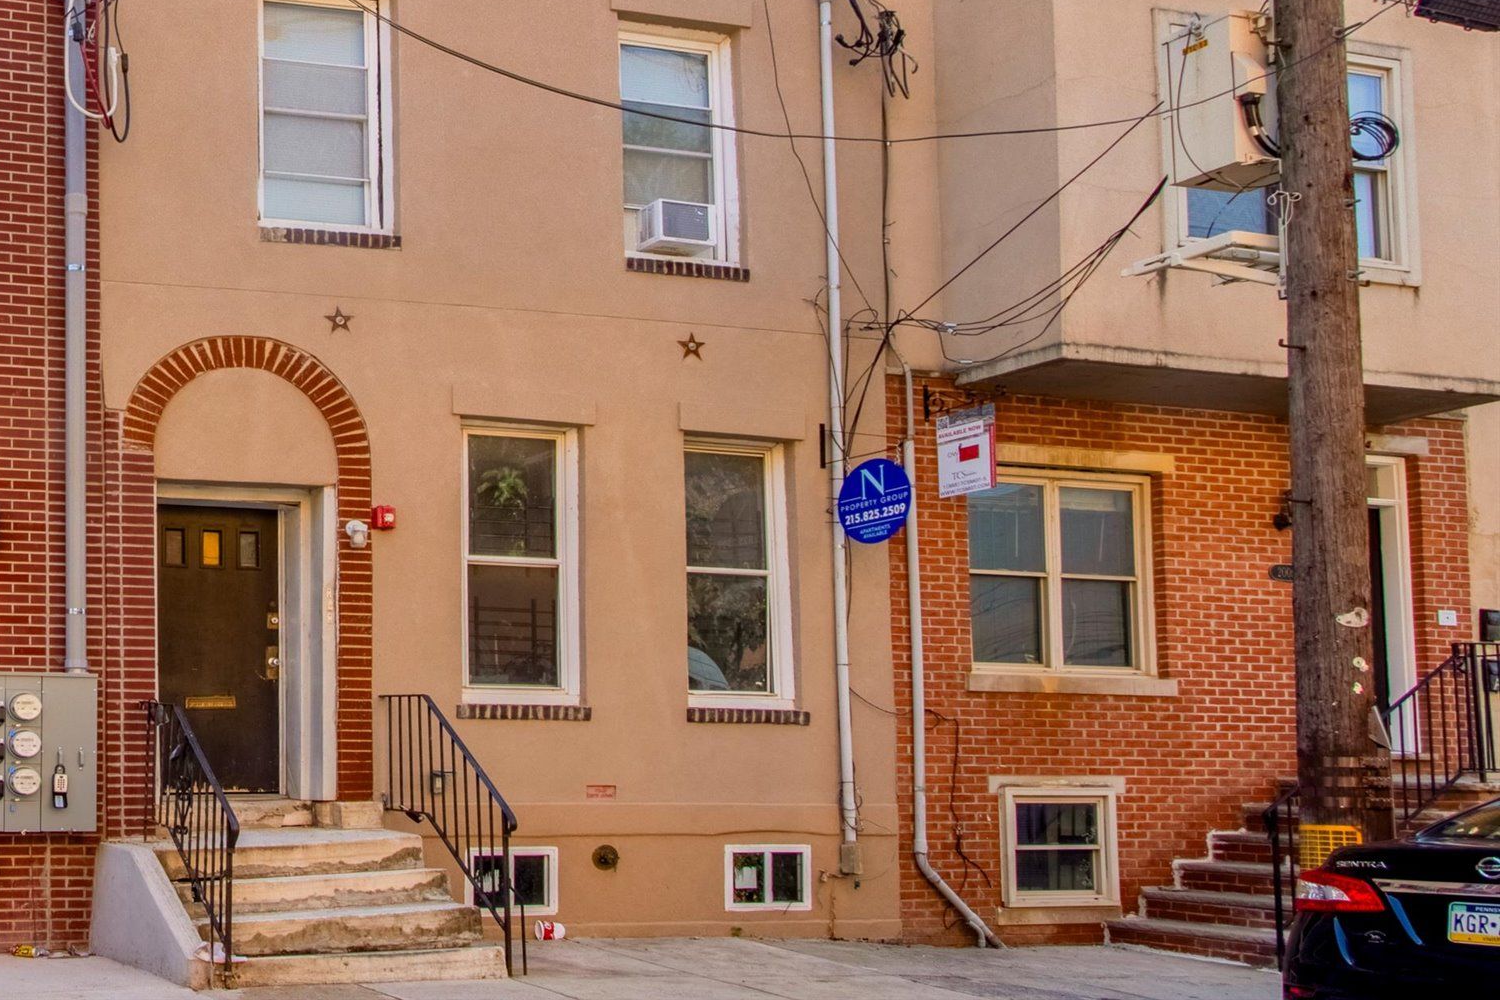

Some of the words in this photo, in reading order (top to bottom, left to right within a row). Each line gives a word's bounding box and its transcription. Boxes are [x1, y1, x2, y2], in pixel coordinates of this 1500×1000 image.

[860, 464, 885, 500] N
[840, 499, 877, 512] PROPERTY
[880, 491, 909, 503] GROUP
[845, 503, 906, 525] 215.825.2509
[1336, 860, 1387, 869] SENTRA
